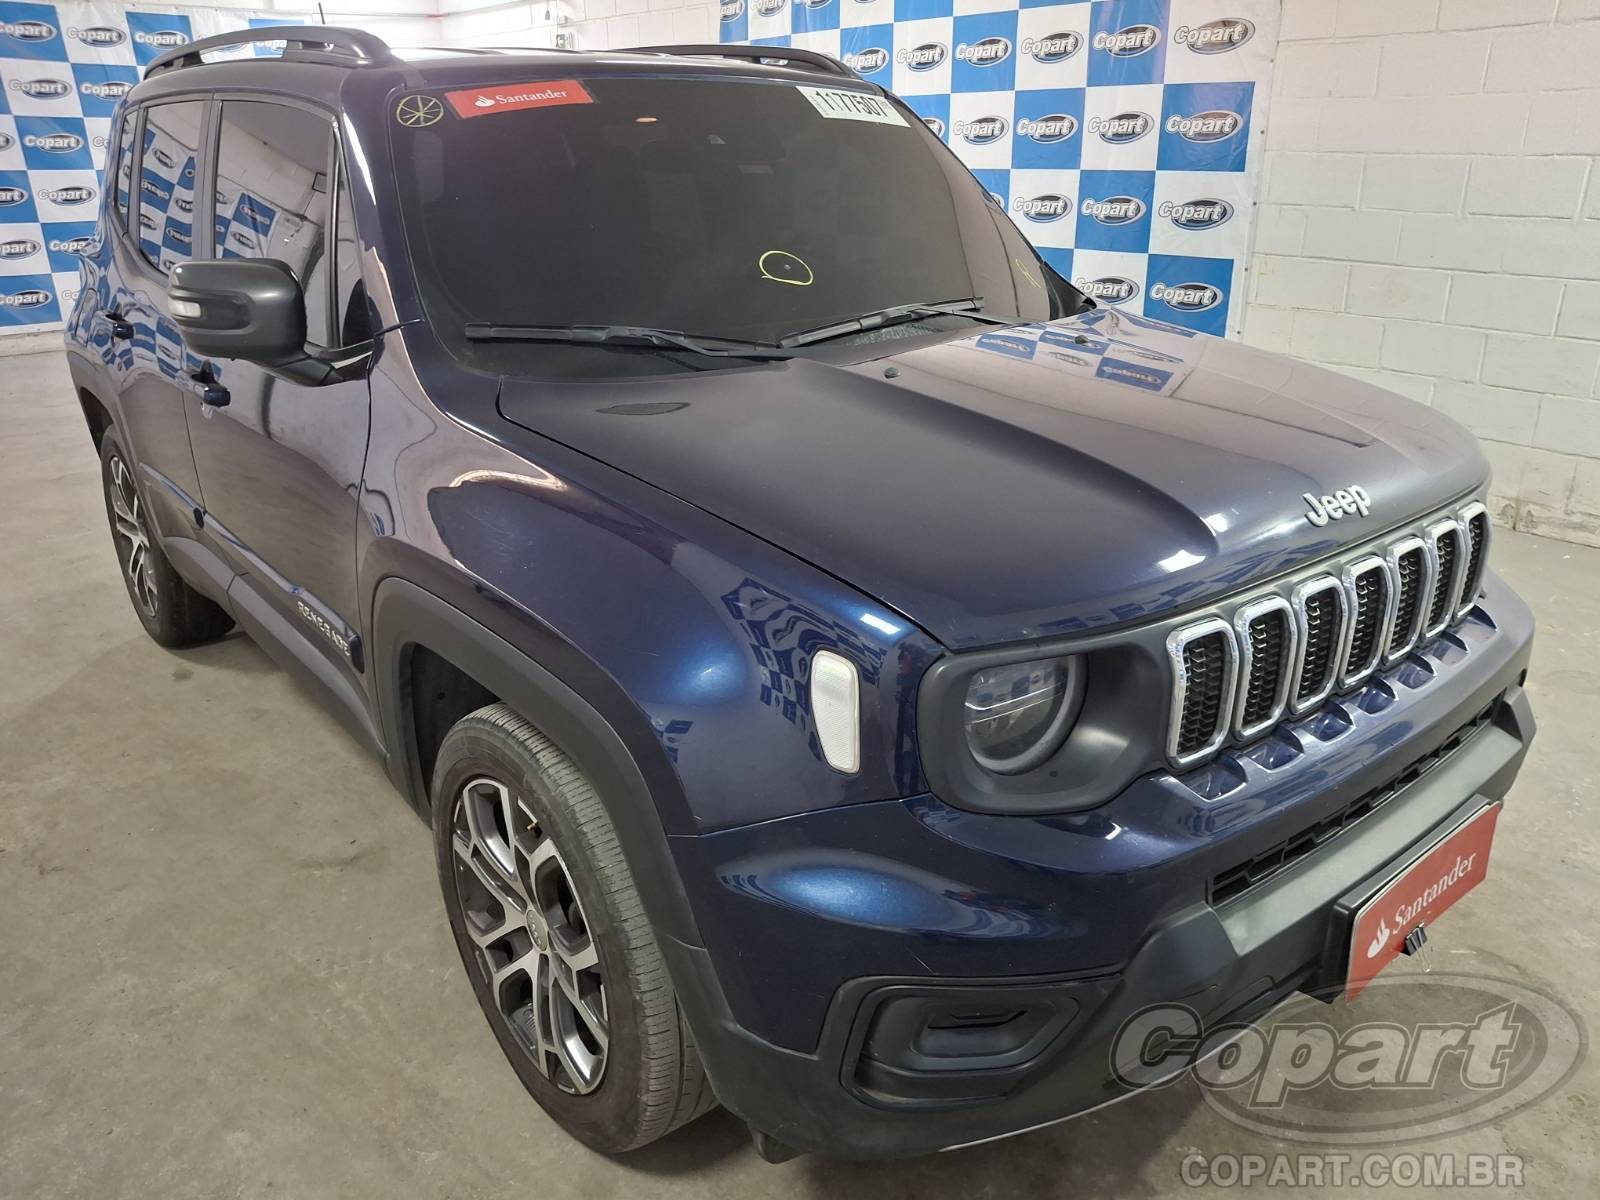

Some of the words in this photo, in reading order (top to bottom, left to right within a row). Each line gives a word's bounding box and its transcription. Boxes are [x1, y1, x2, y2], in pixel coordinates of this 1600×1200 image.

[66, 27, 120, 43] Copart
[135, 32, 183, 45] Copart
[1021, 32, 1076, 60] Copart
[1093, 25, 1154, 55] Copart
[1174, 21, 1246, 49] Copart
[896, 47, 942, 67] Copart
[955, 38, 1005, 62] Copart
[8, 79, 65, 95] Copart
[495, 89, 568, 104] Santander
[816, 90, 888, 117] 1177507
[953, 117, 1003, 140] Copart
[1016, 116, 1073, 139] Copart
[1088, 115, 1147, 138] Copart
[1166, 113, 1236, 138] Copart
[24, 135, 78, 149] Copart
[38, 189, 89, 202] Copart
[1012, 196, 1067, 220] Copart
[1081, 198, 1138, 221] Copart
[1158, 201, 1224, 224] Copart
[0, 240, 34, 255] part
[1150, 283, 1216, 308] Copart
[1302, 485, 1371, 527] Jeep
[1393, 852, 1476, 935] Santander
